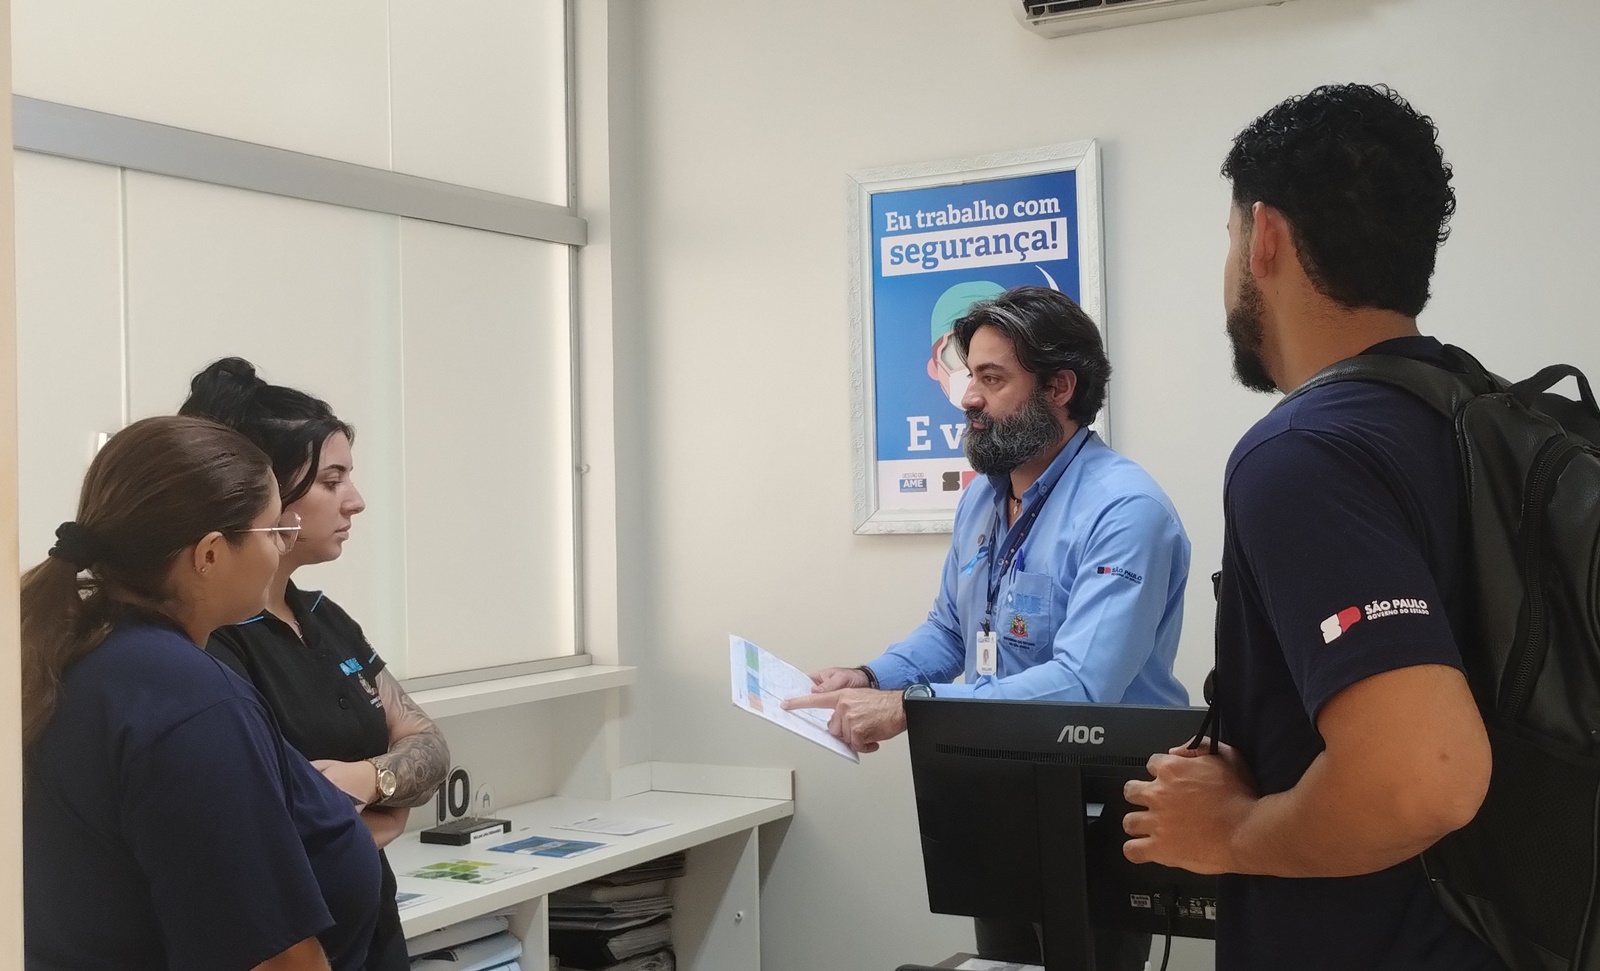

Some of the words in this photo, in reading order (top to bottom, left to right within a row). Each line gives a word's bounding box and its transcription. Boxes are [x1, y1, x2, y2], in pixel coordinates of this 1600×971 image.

[885, 211, 912, 232] Eu
[915, 199, 1009, 228] trabalho
[1013, 197, 1061, 217] com
[889, 220, 1058, 270] segurança!
[906, 415, 932, 452] E
[903, 479, 924, 488] AME
[1123, 570, 1142, 581] PAULO
[1364, 600, 1391, 615] SÃO
[1392, 598, 1428, 610] PAULO
[1367, 609, 1398, 621] GOVERNO
[1410, 608, 1430, 616] ESTADO
[1056, 725, 1105, 745] AOC
[439, 769, 470, 822] 10
